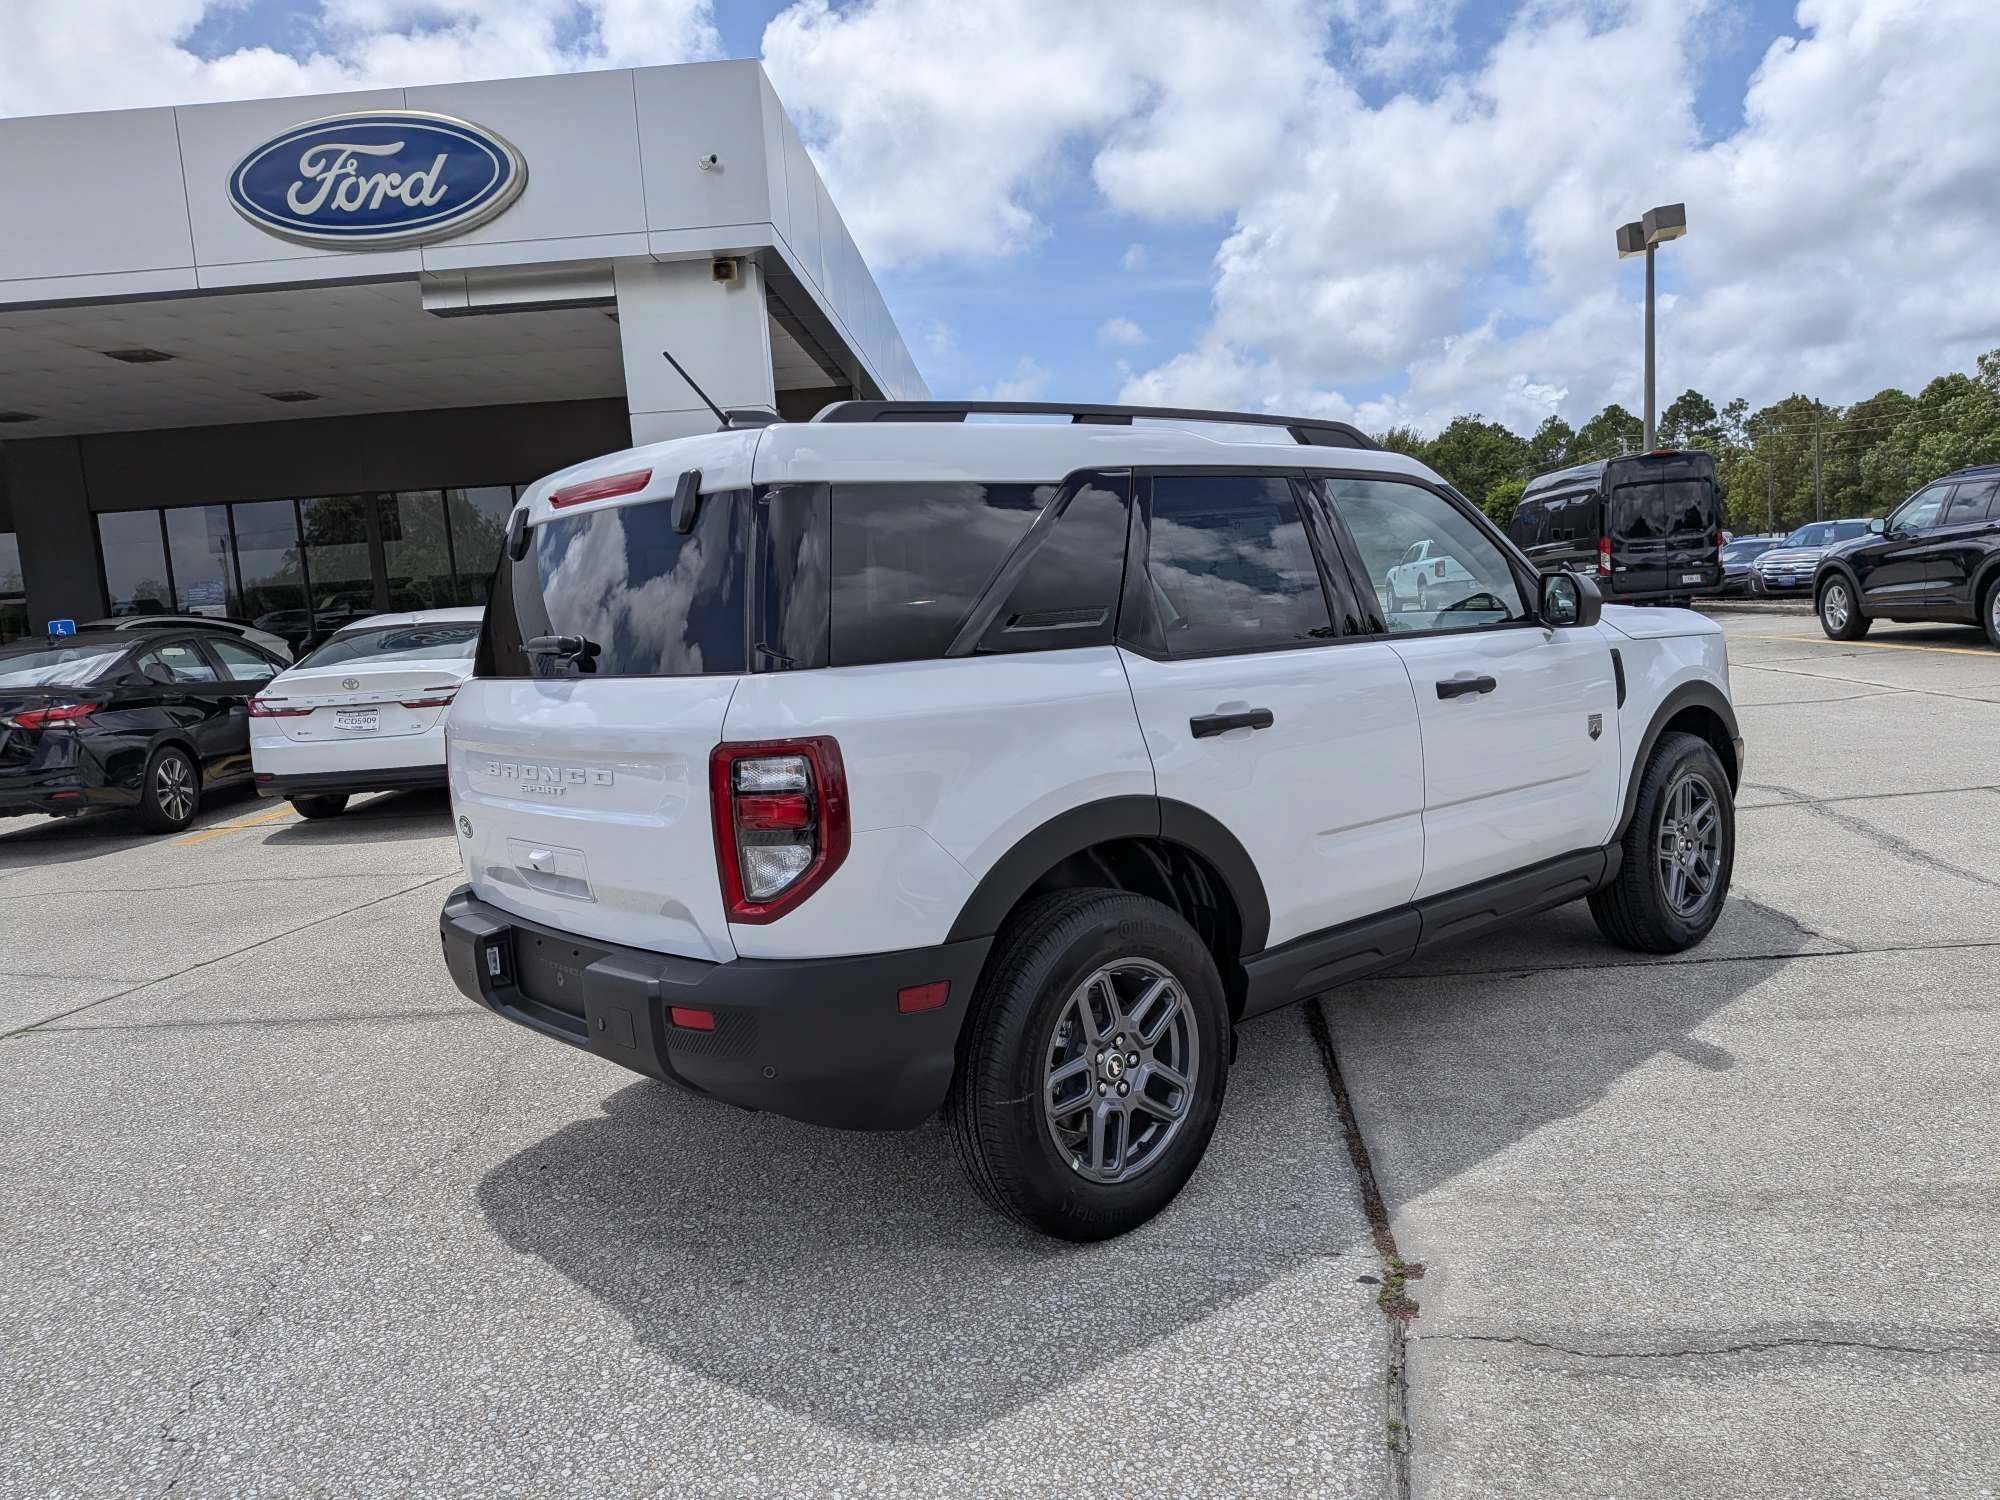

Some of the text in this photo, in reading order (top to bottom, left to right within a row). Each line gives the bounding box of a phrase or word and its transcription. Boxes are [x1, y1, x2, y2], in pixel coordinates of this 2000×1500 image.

[287, 141, 449, 216] Ford
[487, 761, 615, 786] BRONCO
[519, 783, 567, 795] SPORT
